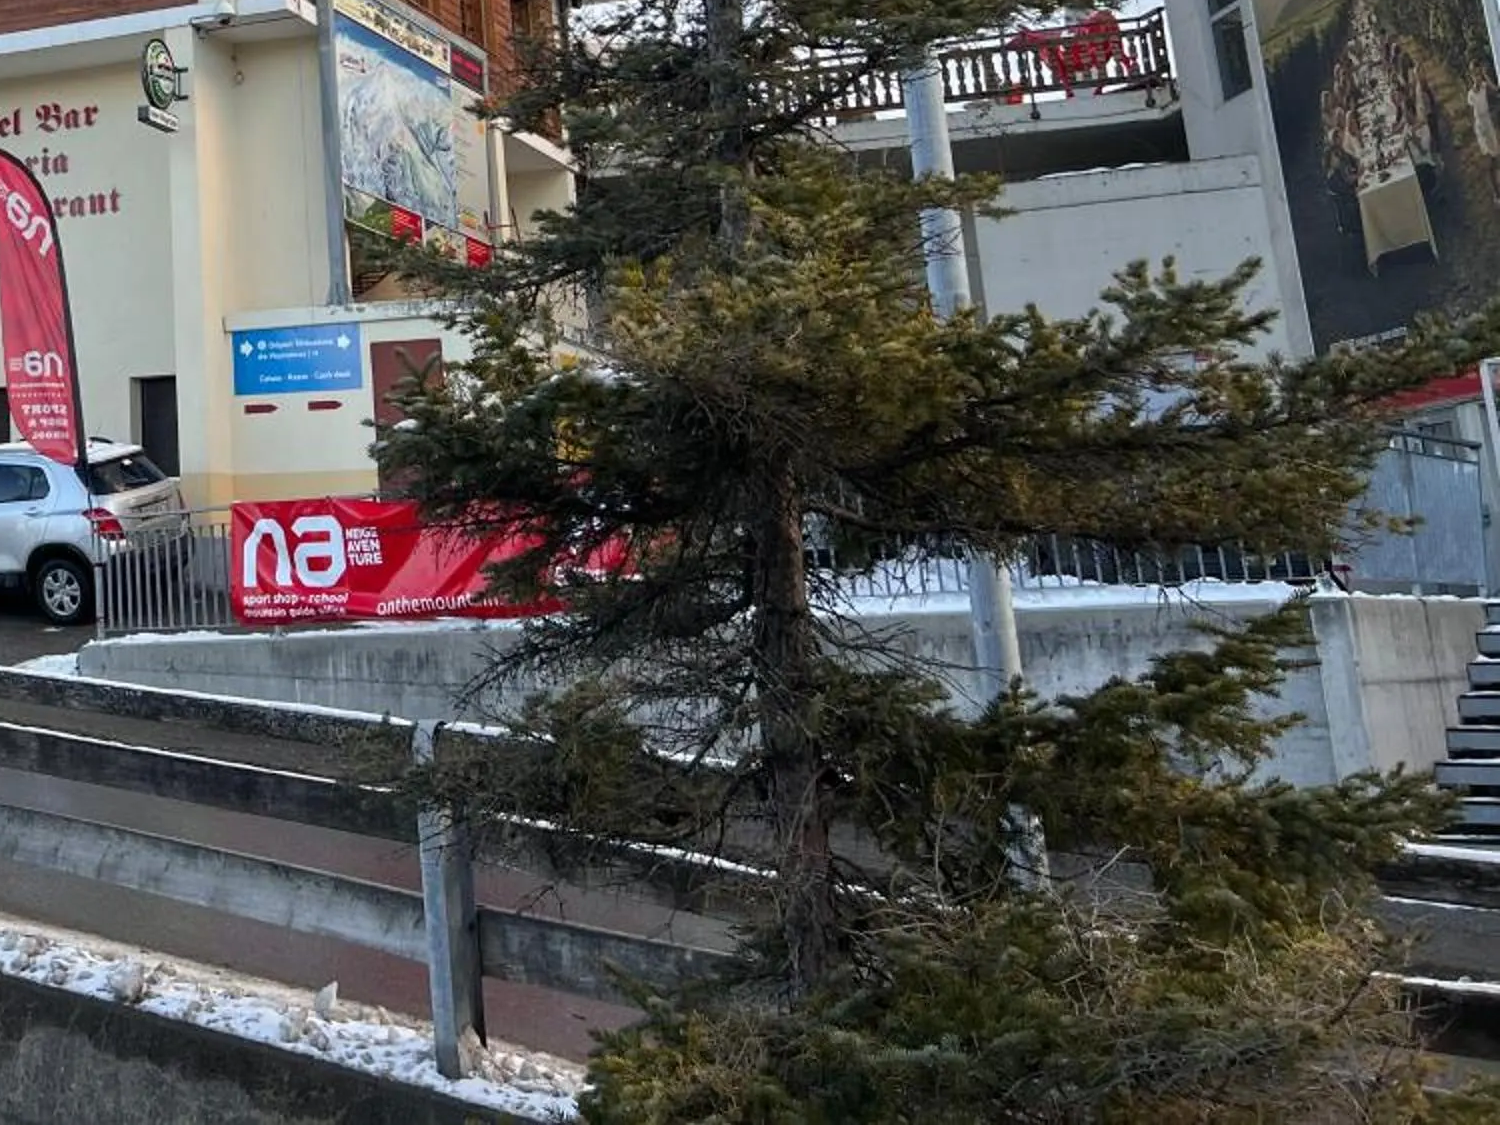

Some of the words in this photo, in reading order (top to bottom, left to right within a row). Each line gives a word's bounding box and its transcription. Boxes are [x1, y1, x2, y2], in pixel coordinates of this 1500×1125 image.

[35, 102, 99, 134] Bar
[346, 526, 378, 538] NEIGE
[347, 538, 380, 552] AVEN
[348, 552, 383, 566] TURE
[243, 594, 271, 607] sport
[273, 593, 298, 605] shop
[308, 592, 349, 603] school
[243, 606, 287, 618] mountain
[288, 607, 316, 617] guide
